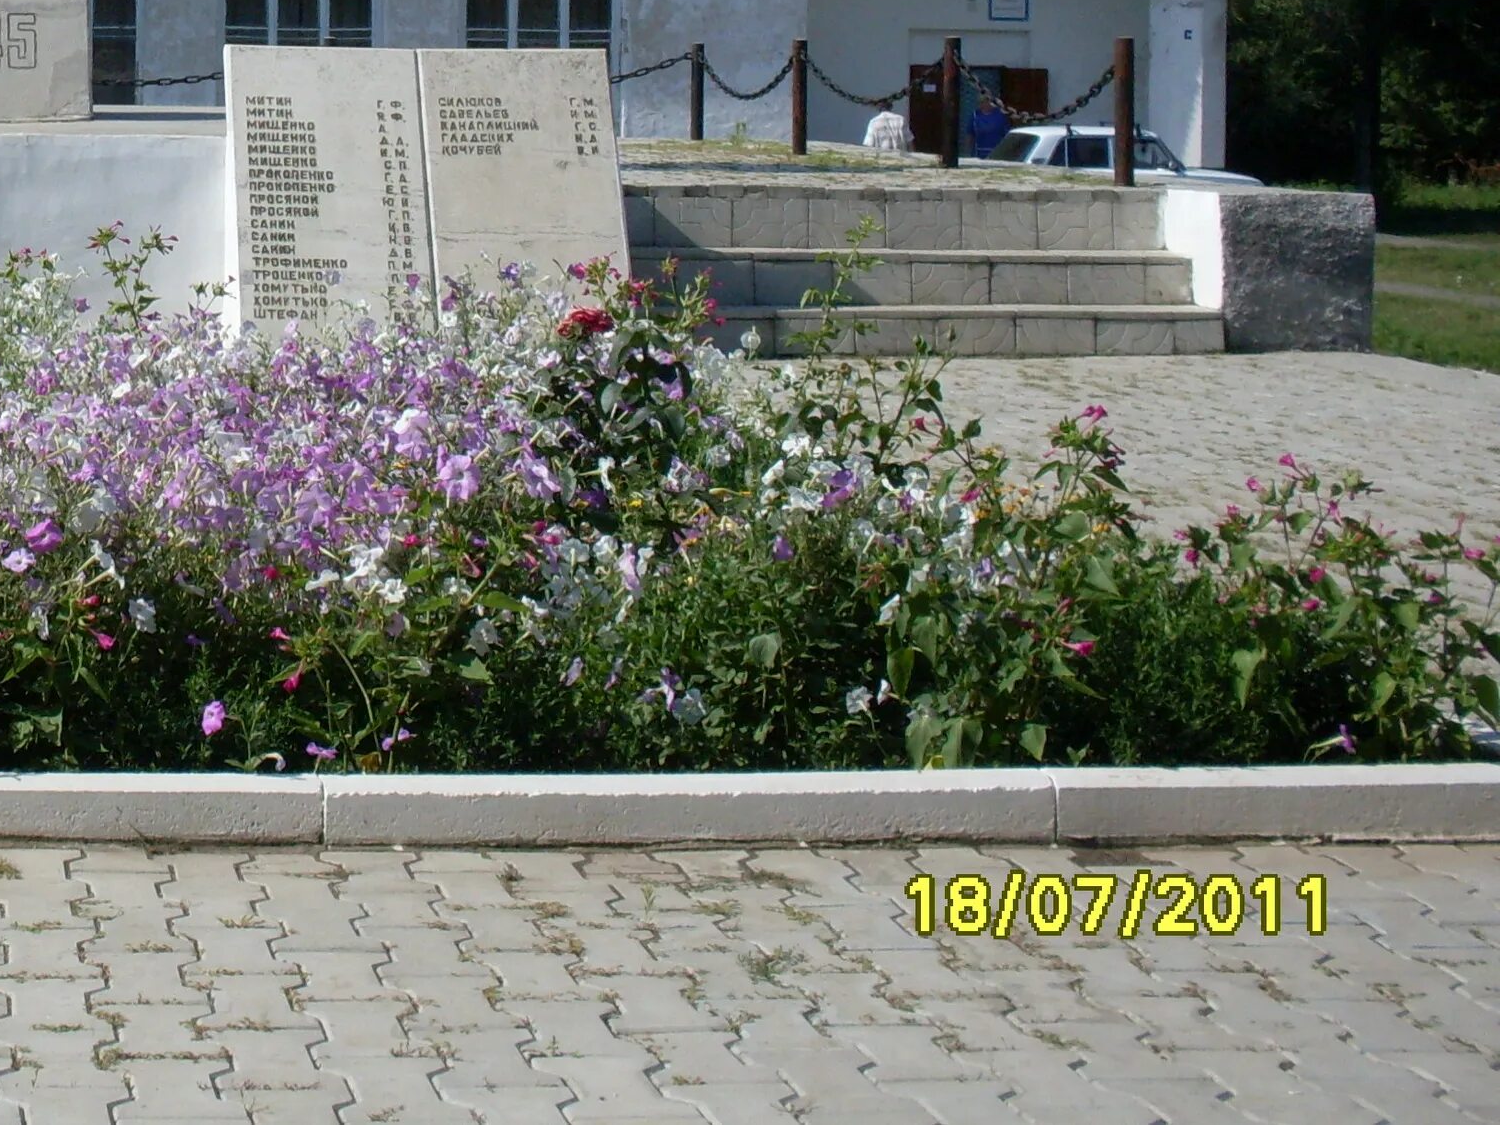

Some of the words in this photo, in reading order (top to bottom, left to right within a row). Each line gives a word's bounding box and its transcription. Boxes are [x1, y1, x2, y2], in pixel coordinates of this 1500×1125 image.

[245, 95, 292, 107] МИТИН
[438, 97, 502, 107] СИЛЮКОВ
[245, 107, 292, 119] МИТИН
[439, 109, 509, 119] САВЕЛЬЕВ
[442, 144, 501, 156] КОЧУБЕЙ
[248, 167, 334, 181] ПРОКОПЕНКО
[248, 180, 335, 193] ПРОКОПЕНКО
[250, 218, 295, 229] САНИН
[250, 231, 295, 242] САНИН
[252, 256, 347, 269] ТРОФИМЕНКО
[252, 269, 323, 281] ТРОЦЕНКО
[253, 307, 317, 320] ШТЕФАН
